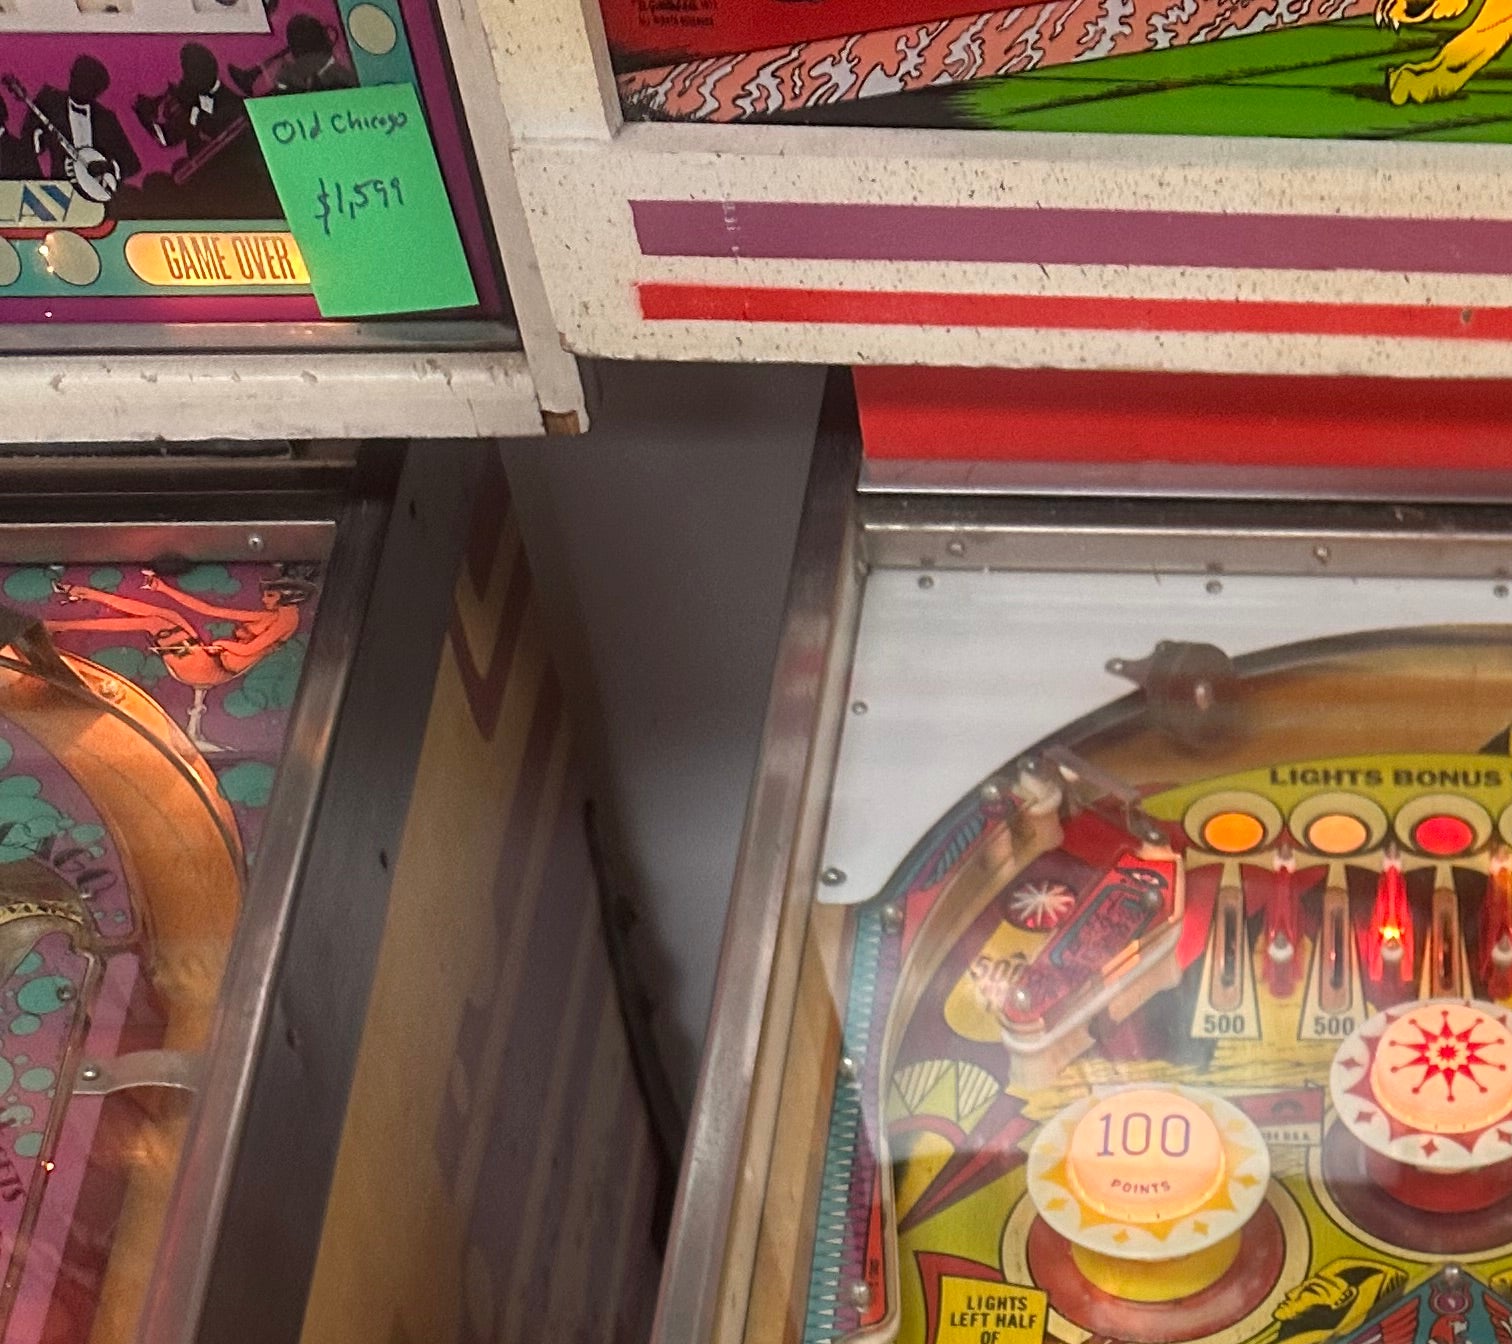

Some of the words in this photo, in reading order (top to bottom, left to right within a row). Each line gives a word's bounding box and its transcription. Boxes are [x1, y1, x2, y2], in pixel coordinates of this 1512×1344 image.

[272, 111, 321, 144] Old
[330, 110, 408, 135] Chicago
[314, 177, 404, 236] $1,599
[160, 236, 232, 280] GAME
[231, 234, 297, 280] OVER
[1269, 767, 1383, 786] LIGHTS
[1393, 768, 1501, 788] BONUS
[1204, 1014, 1246, 1034] 500
[1313, 1016, 1355, 1036] 500
[1097, 1112, 1191, 1158] 100
[1111, 1179, 1171, 1195] POINTS
[967, 1296, 1028, 1312] LIGHTS
[950, 1312, 990, 1328] LEFT
[996, 1313, 1037, 1329] HALF
